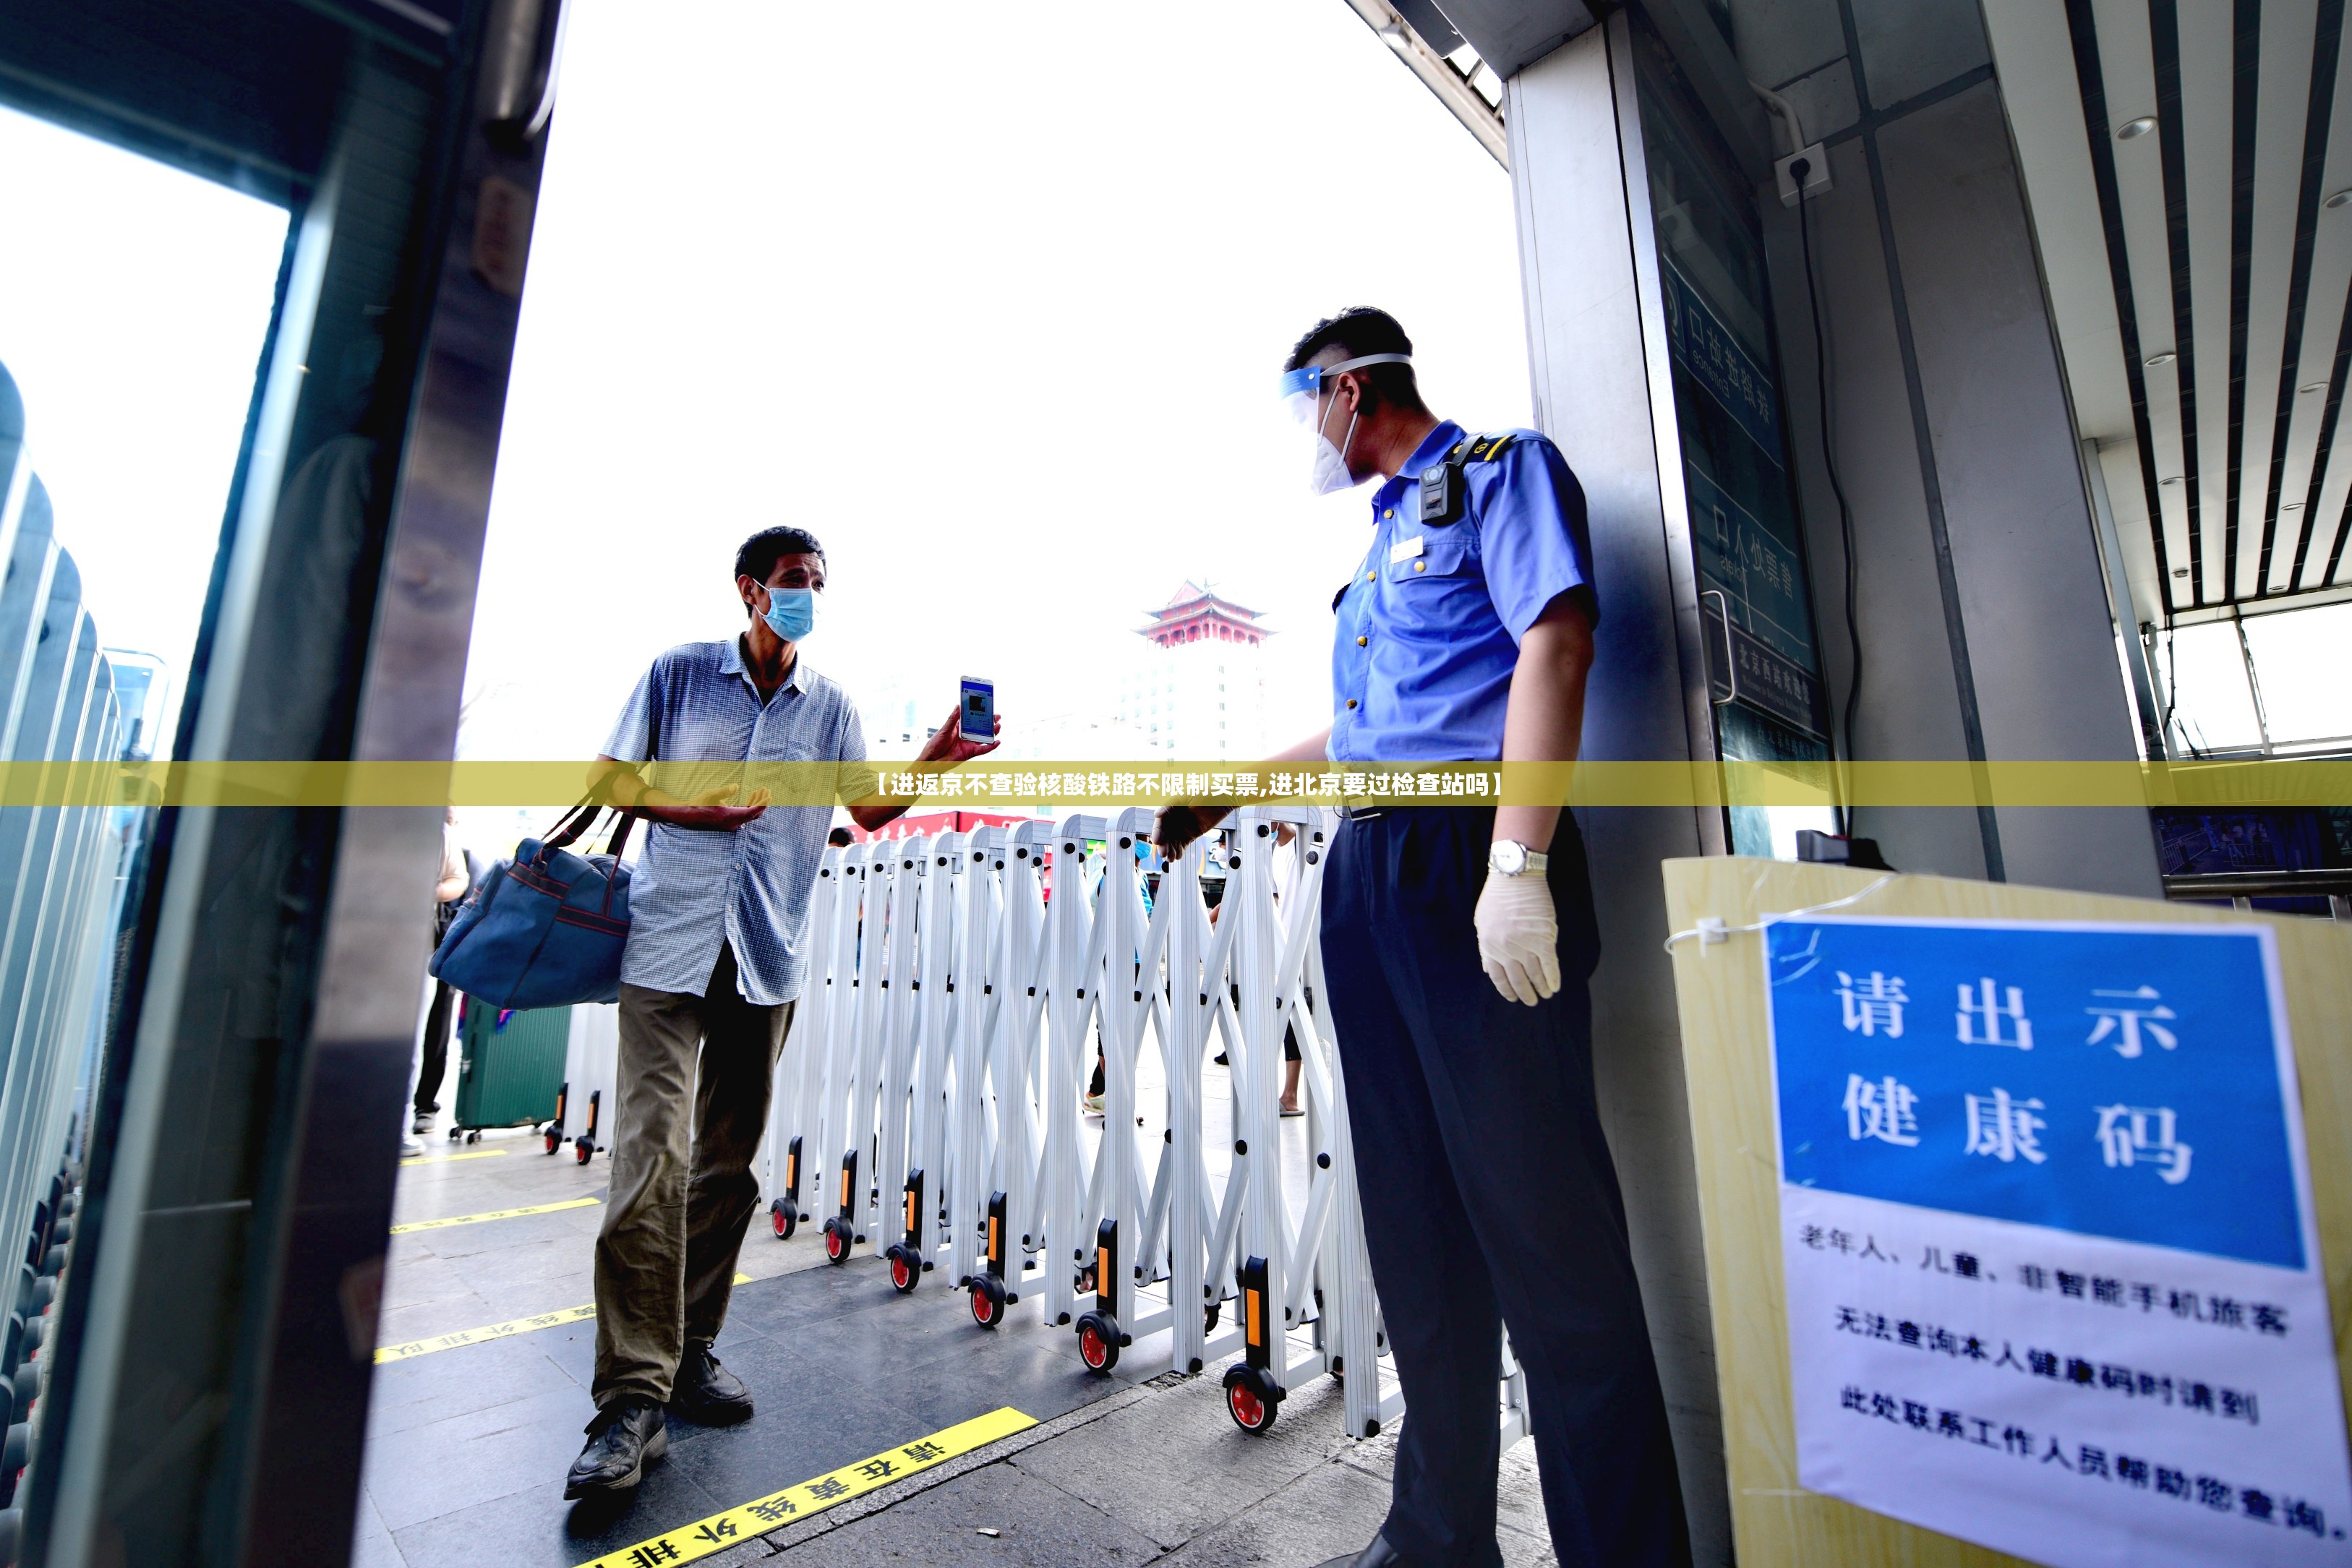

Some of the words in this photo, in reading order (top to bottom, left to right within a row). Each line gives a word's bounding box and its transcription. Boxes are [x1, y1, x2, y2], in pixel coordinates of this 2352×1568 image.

[1834, 971, 2178, 1059] 请出示
[1842, 1073, 2194, 1185] 健康码
[1834, 1305, 2260, 1426] 无法查询本人健康码时请到
[594, 1440, 944, 1568] 请在黄线外排
